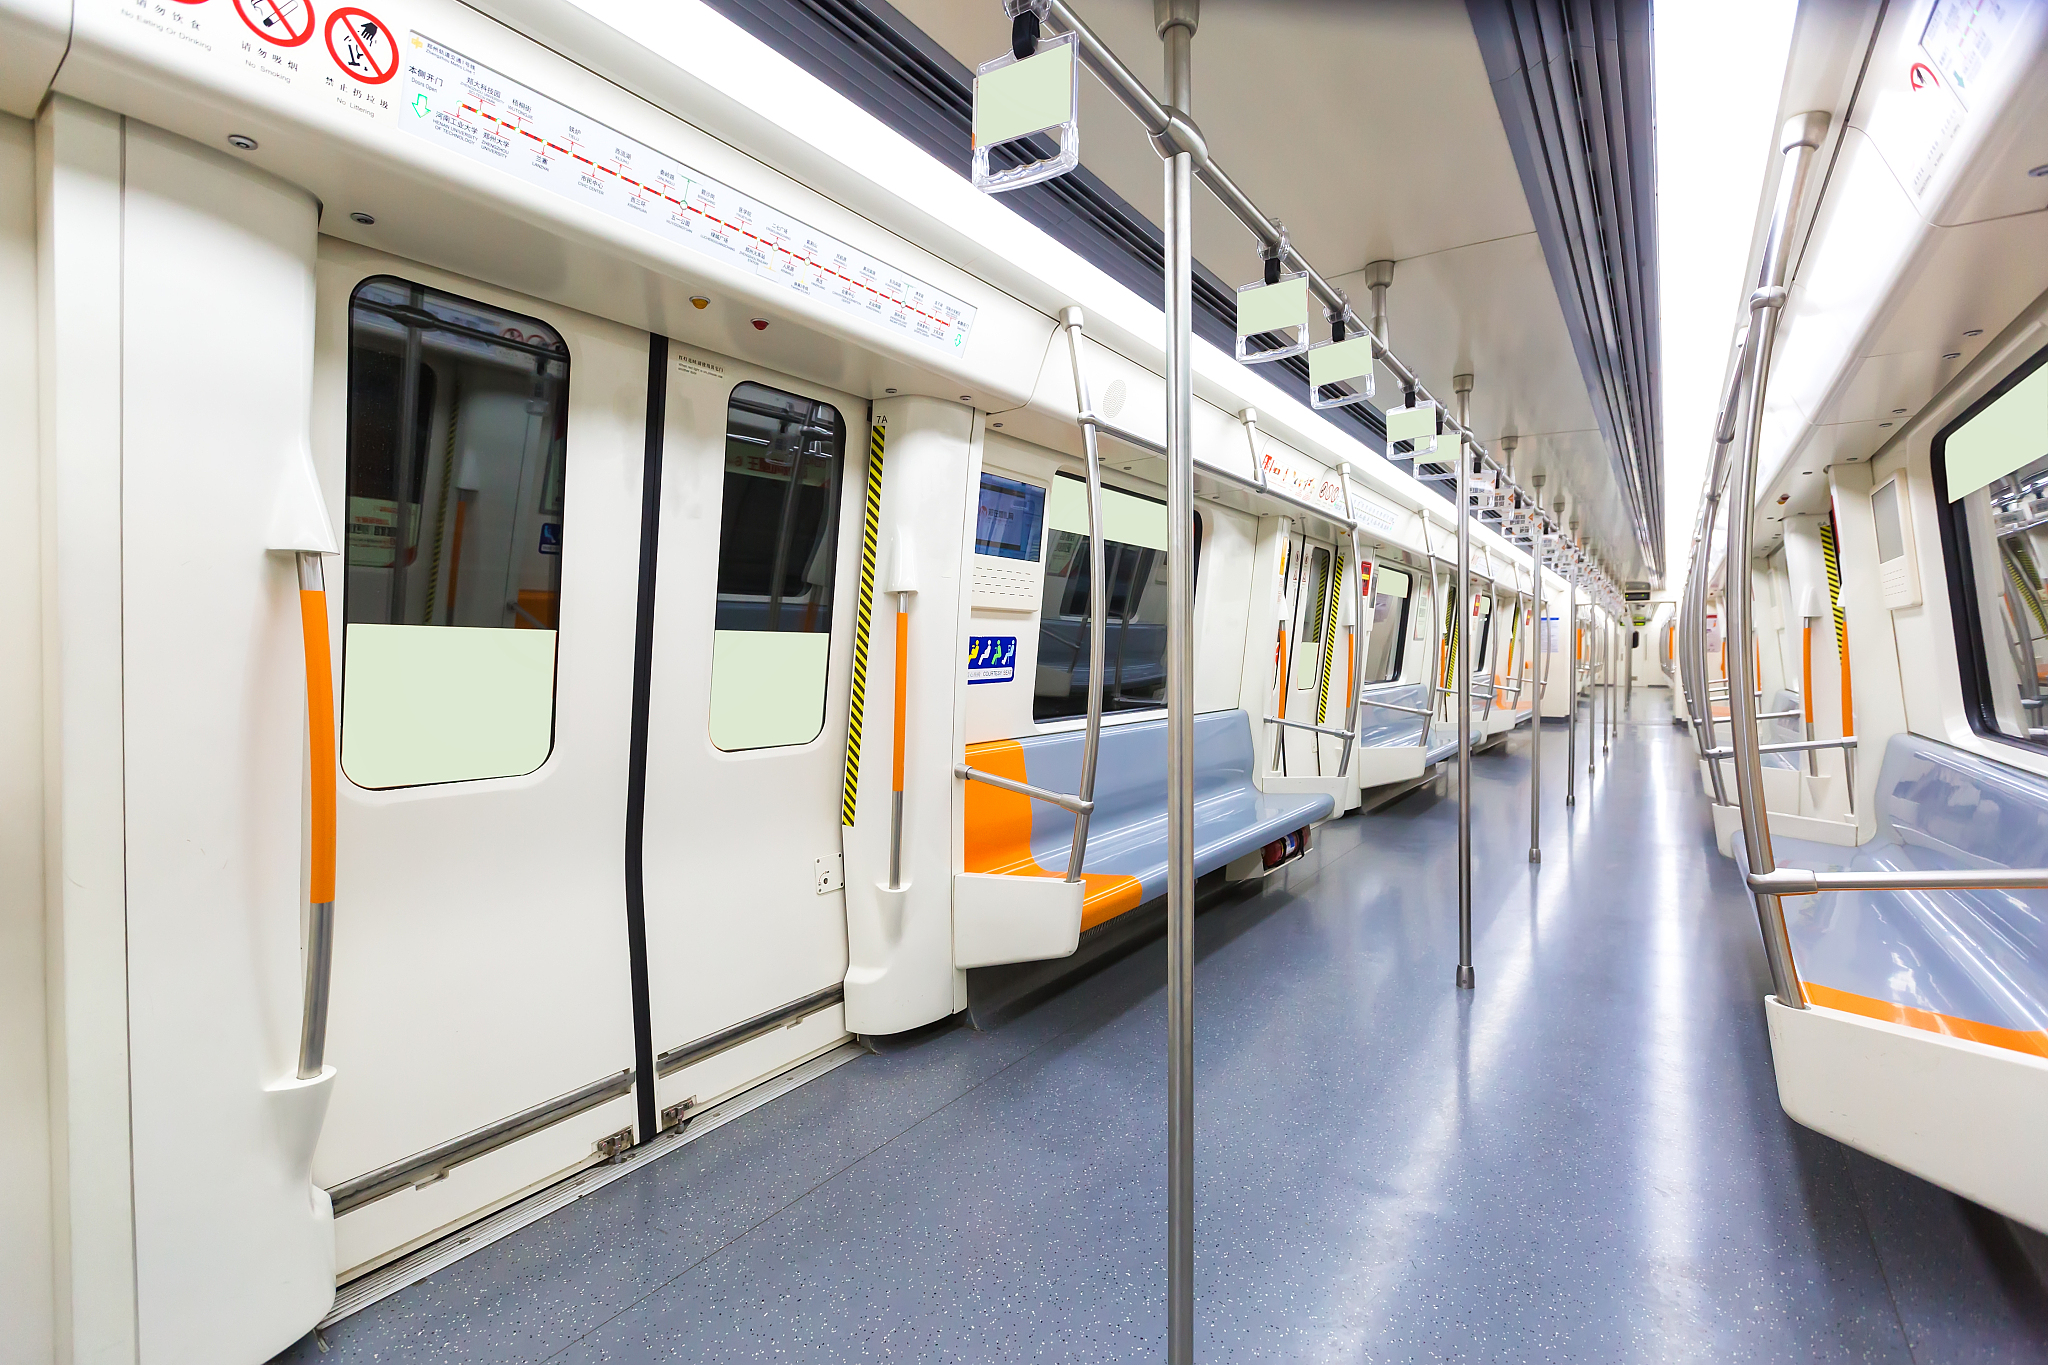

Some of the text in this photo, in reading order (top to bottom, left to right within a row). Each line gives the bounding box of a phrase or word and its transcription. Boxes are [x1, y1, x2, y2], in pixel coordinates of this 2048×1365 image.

[121, 8, 212, 52] No Eating Or Drinking
[241, 40, 298, 72] 请勿吸烟
[245, 59, 291, 84] No Smoking
[408, 65, 443, 87] 本侧开门
[325, 76, 389, 110] 禁止扔垃圾
[425, 83, 437, 93] Open
[336, 97, 375, 118] No Littering
[435, 110, 478, 134] 河南工业大学
[442, 128, 475, 145] TECHNOLOGY
[482, 132, 510, 148] 郑州大学
[876, 415, 888, 424] 7A
